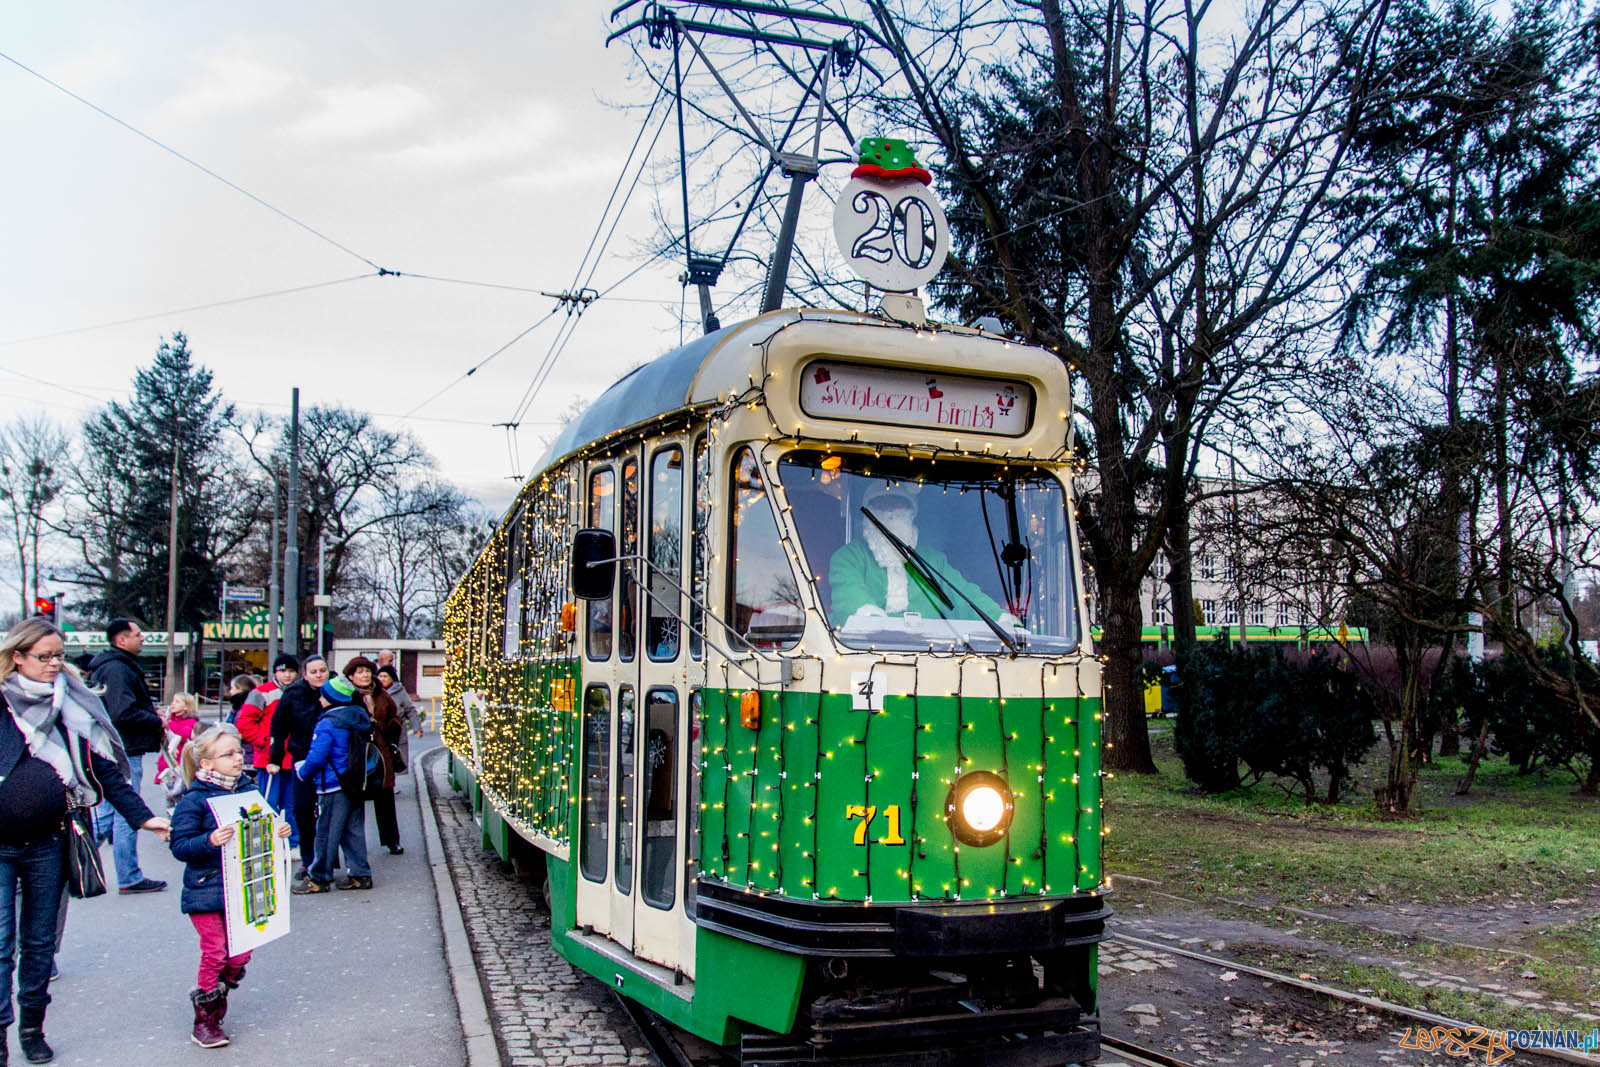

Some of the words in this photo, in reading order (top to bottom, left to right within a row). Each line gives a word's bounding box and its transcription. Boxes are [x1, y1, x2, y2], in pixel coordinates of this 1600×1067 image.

[852, 190, 937, 270] 20
[858, 681, 874, 700] 4
[846, 805, 906, 846] 71
